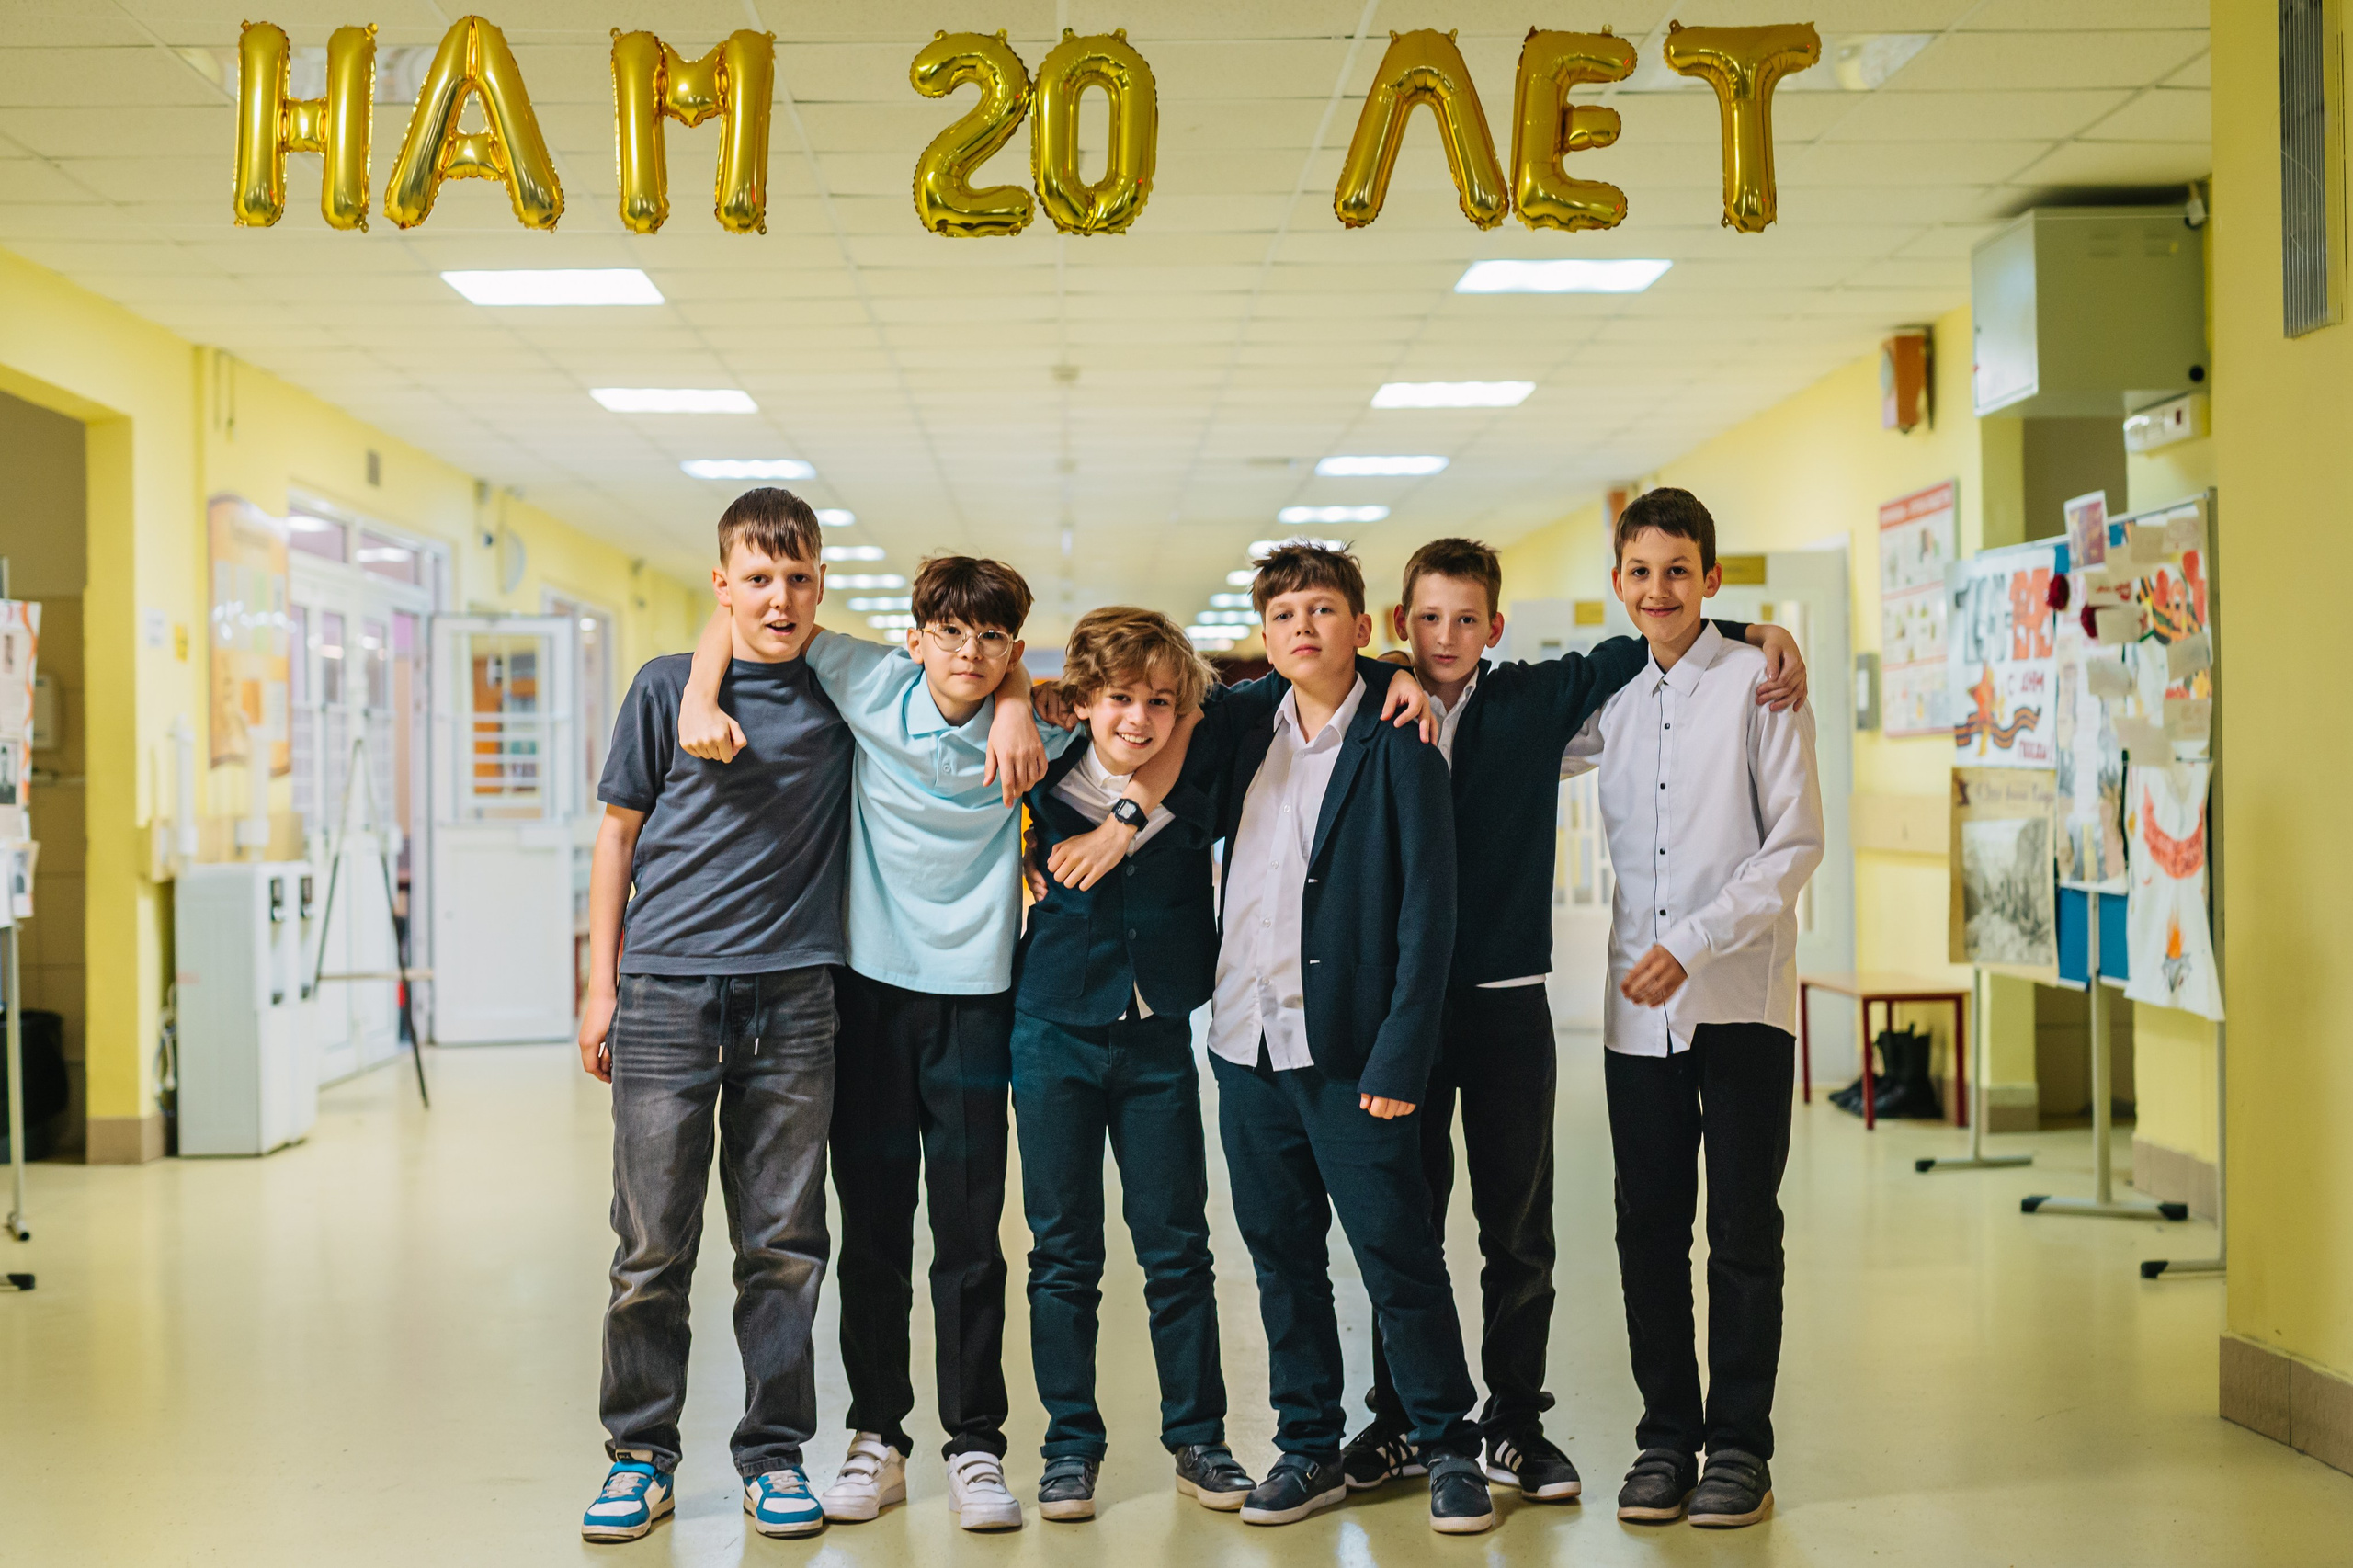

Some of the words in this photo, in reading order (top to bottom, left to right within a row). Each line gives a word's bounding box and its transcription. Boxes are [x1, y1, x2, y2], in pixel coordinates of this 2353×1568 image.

[232, 15, 777, 234] НАМ
[909, 26, 1161, 237] 20
[1334, 20, 1822, 234] ЛЕТ
